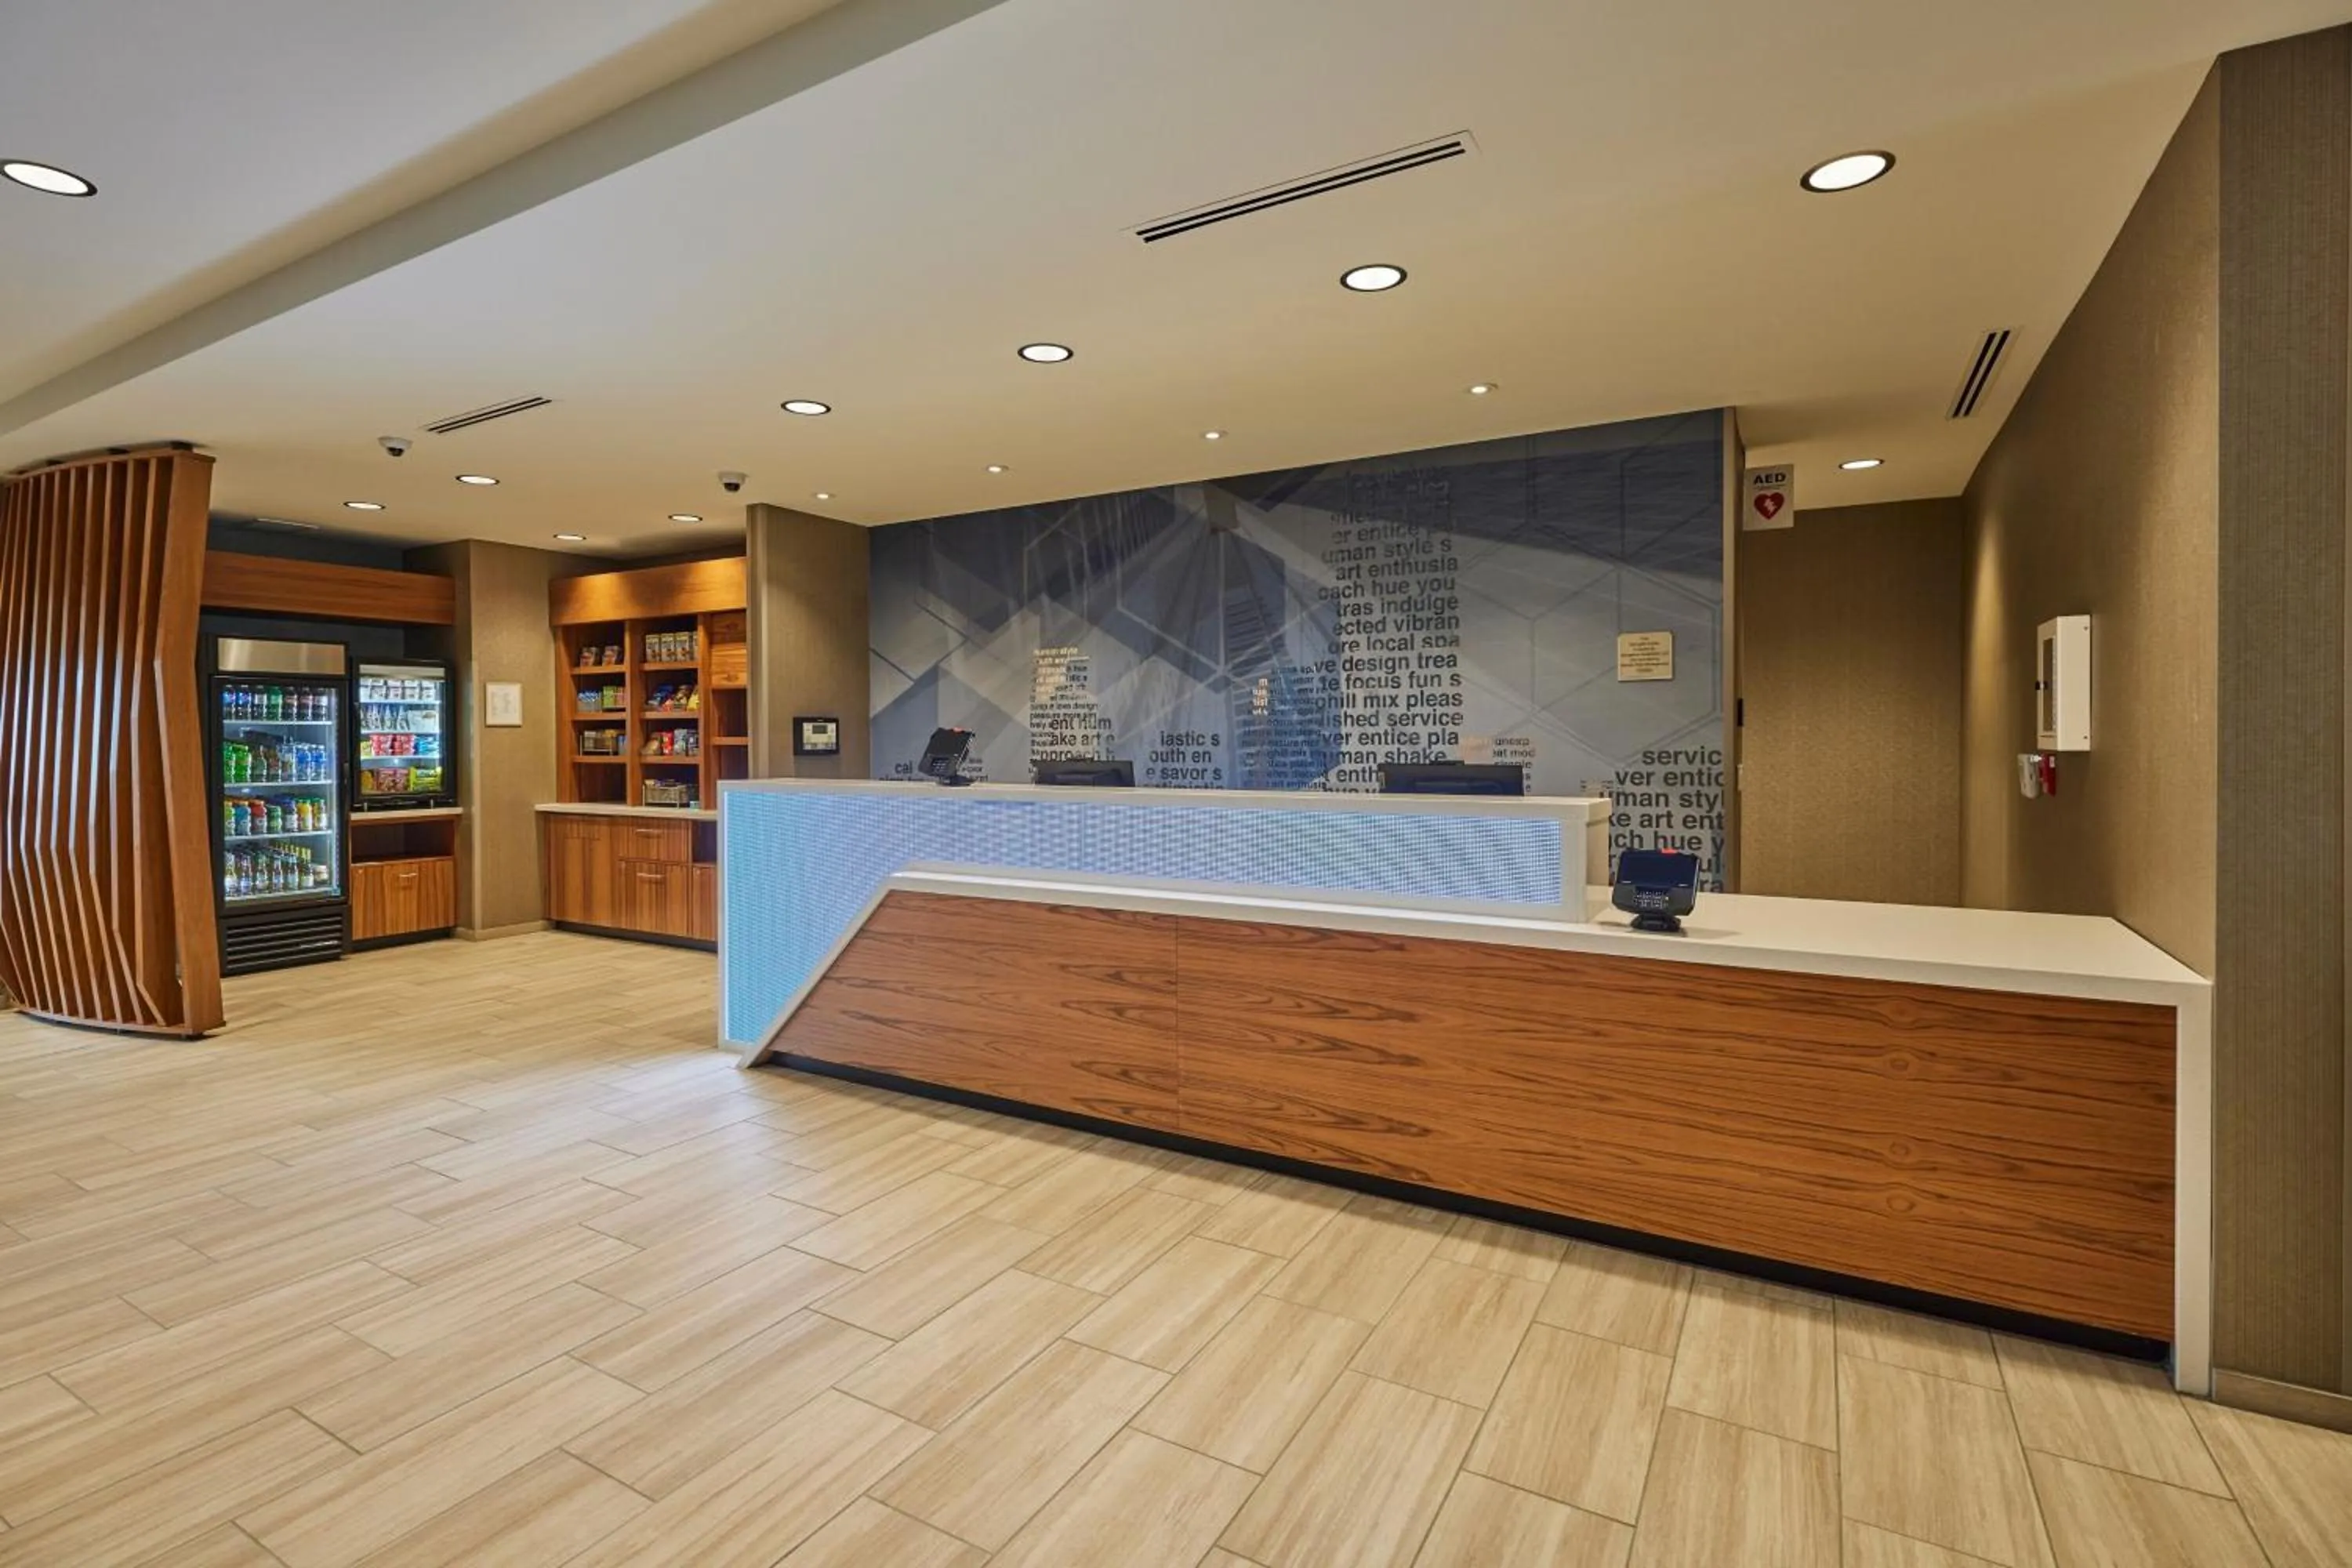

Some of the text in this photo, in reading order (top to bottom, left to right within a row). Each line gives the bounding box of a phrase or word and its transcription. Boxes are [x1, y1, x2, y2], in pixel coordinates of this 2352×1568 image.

[1754, 473, 1787, 485] AED
[1336, 563, 1362, 581] art
[1372, 579, 1410, 597] hue
[1417, 575, 1456, 597] you
[1381, 593, 1459, 616] indulge
[1334, 614, 1461, 636] ected vibran
[1367, 633, 1415, 652] local
[1342, 655, 1410, 675] design
[1417, 652, 1458, 670] trea
[1345, 673, 1402, 691] focus
[1409, 671, 1442, 689] fun
[1450, 672, 1462, 688] s
[1363, 693, 1399, 709] mix
[1406, 689, 1464, 711] pleas
[1386, 709, 1464, 728] service
[1210, 733, 1220, 746] s
[1358, 728, 1421, 746] entice
[1428, 728, 1459, 749] pla
[1149, 748, 1211, 763] outh en
[1385, 747, 1447, 765] shake
[1642, 746, 1722, 766] servic
[1212, 768, 1222, 781] s
[1615, 771, 1655, 786] ver
[1639, 811, 1674, 829] art
[1682, 813, 1724, 830] ent
[1653, 830, 1703, 851] hue
